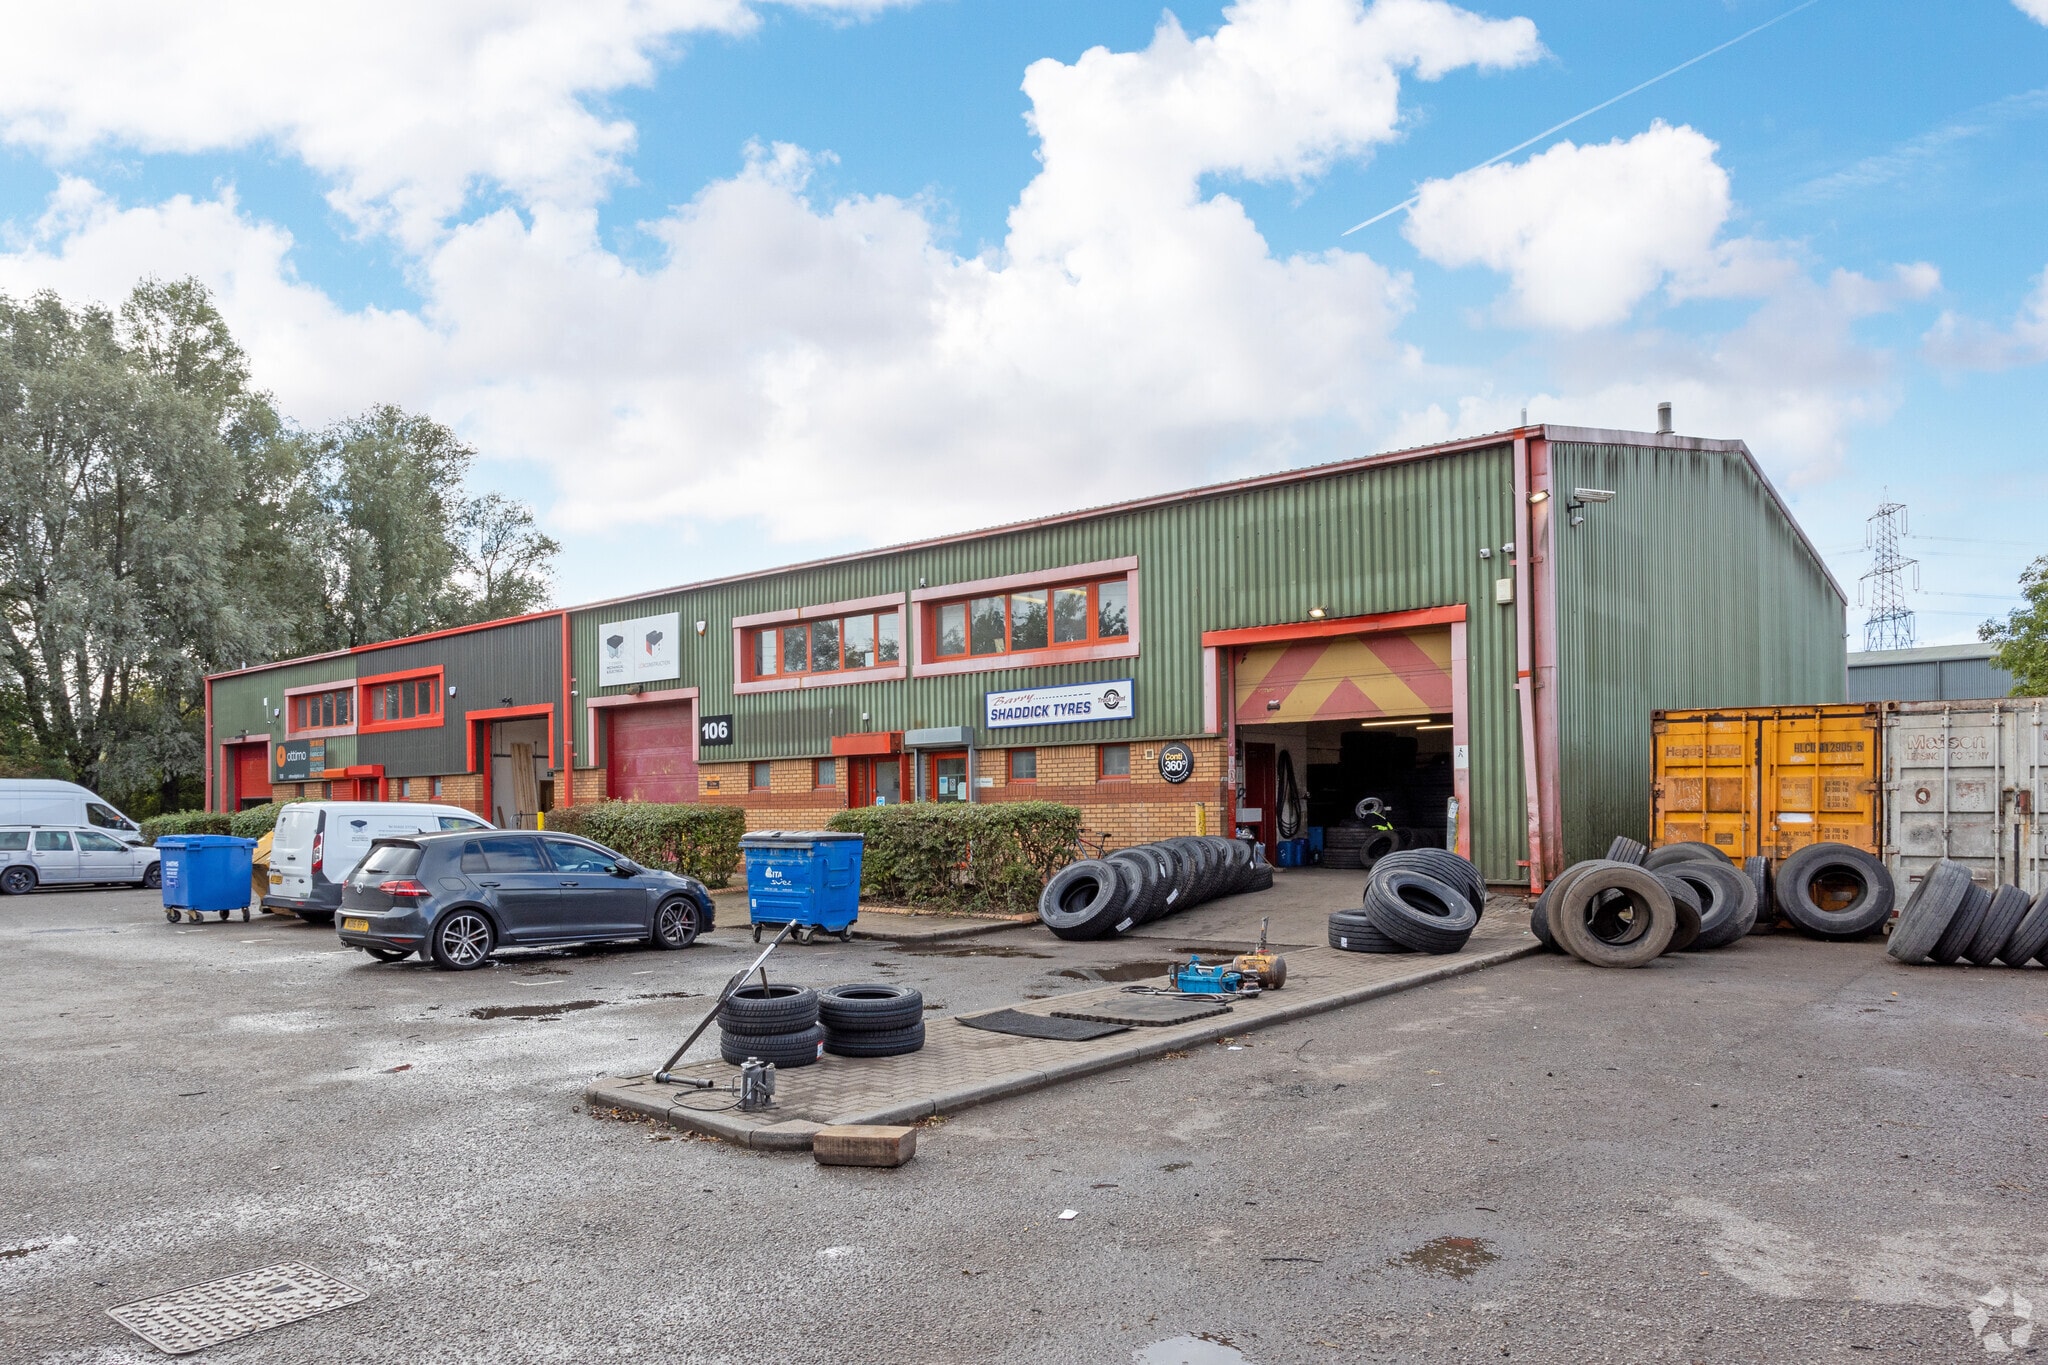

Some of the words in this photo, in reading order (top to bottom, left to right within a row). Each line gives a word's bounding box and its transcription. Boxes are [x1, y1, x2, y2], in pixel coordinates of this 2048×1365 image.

[992, 693, 1035, 707] Barry
[990, 704, 1050, 721] SHADDICK
[1053, 701, 1092, 716] TYRES
[702, 721, 728, 739] 106
[1907, 733, 1986, 750] Matson
[286, 750, 306, 761] ottimo
[1666, 745, 1741, 758] Hapag-Lloyd
